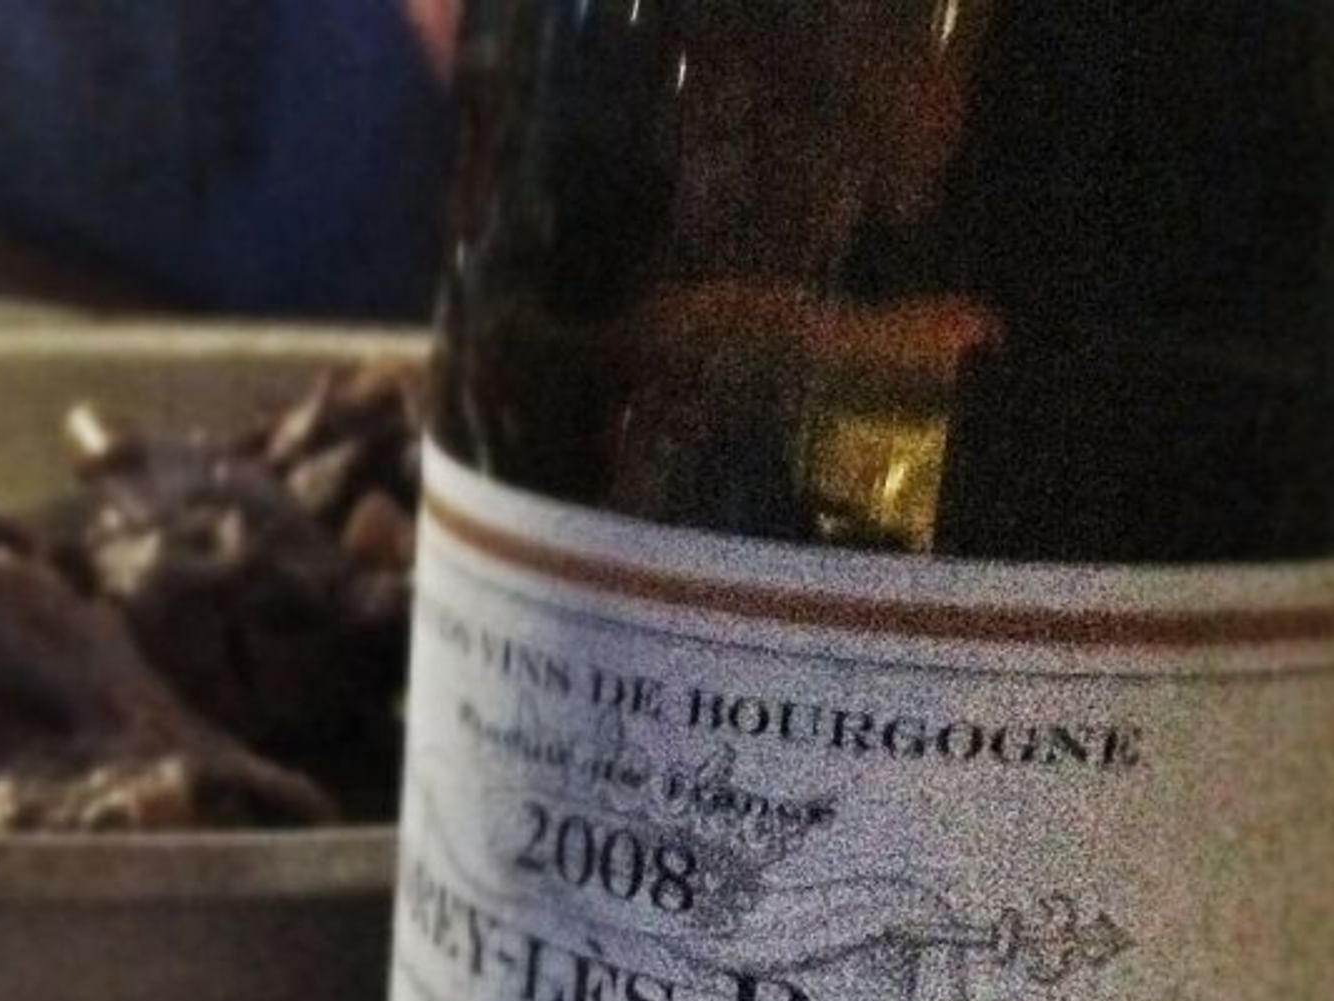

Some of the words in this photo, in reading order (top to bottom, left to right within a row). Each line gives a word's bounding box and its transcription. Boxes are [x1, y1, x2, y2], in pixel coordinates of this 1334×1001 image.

[589, 665, 666, 722] DE
[684, 686, 1143, 767] BOURGOGNE
[513, 802, 698, 914] 2008
